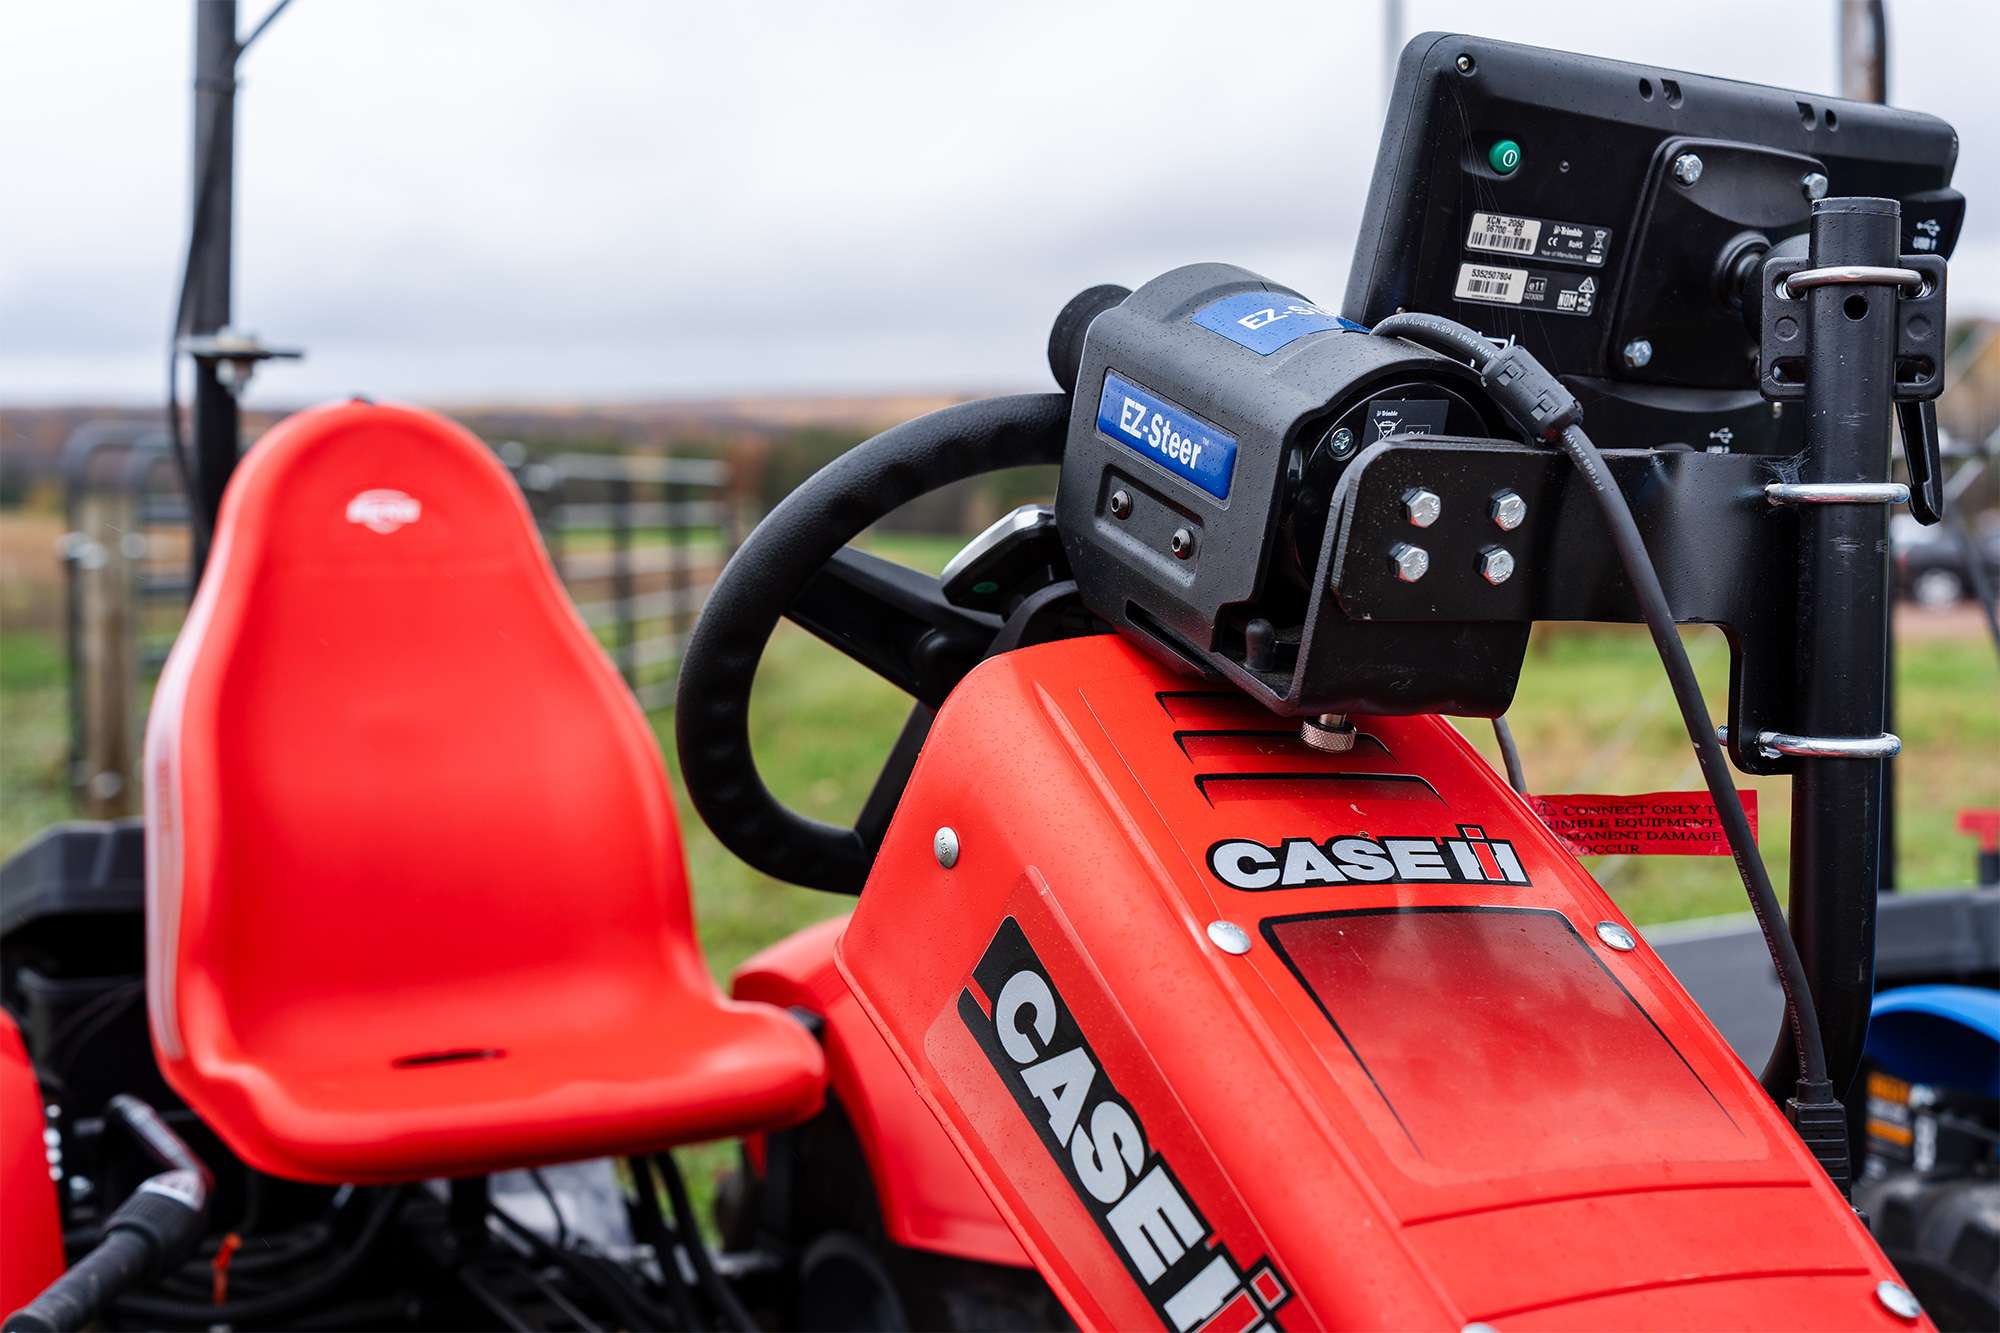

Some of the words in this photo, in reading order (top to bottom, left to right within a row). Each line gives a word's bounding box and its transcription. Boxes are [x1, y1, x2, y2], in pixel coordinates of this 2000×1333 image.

[1120, 396, 1202, 470] EZ-Steer
[1562, 804, 1648, 817] CONNECT
[1651, 804, 1700, 815] ONLY
[1615, 818, 1715, 828] EQUIPMENT
[1646, 831, 1723, 842] DAMAGE
[1581, 843, 1640, 854] OCCUR
